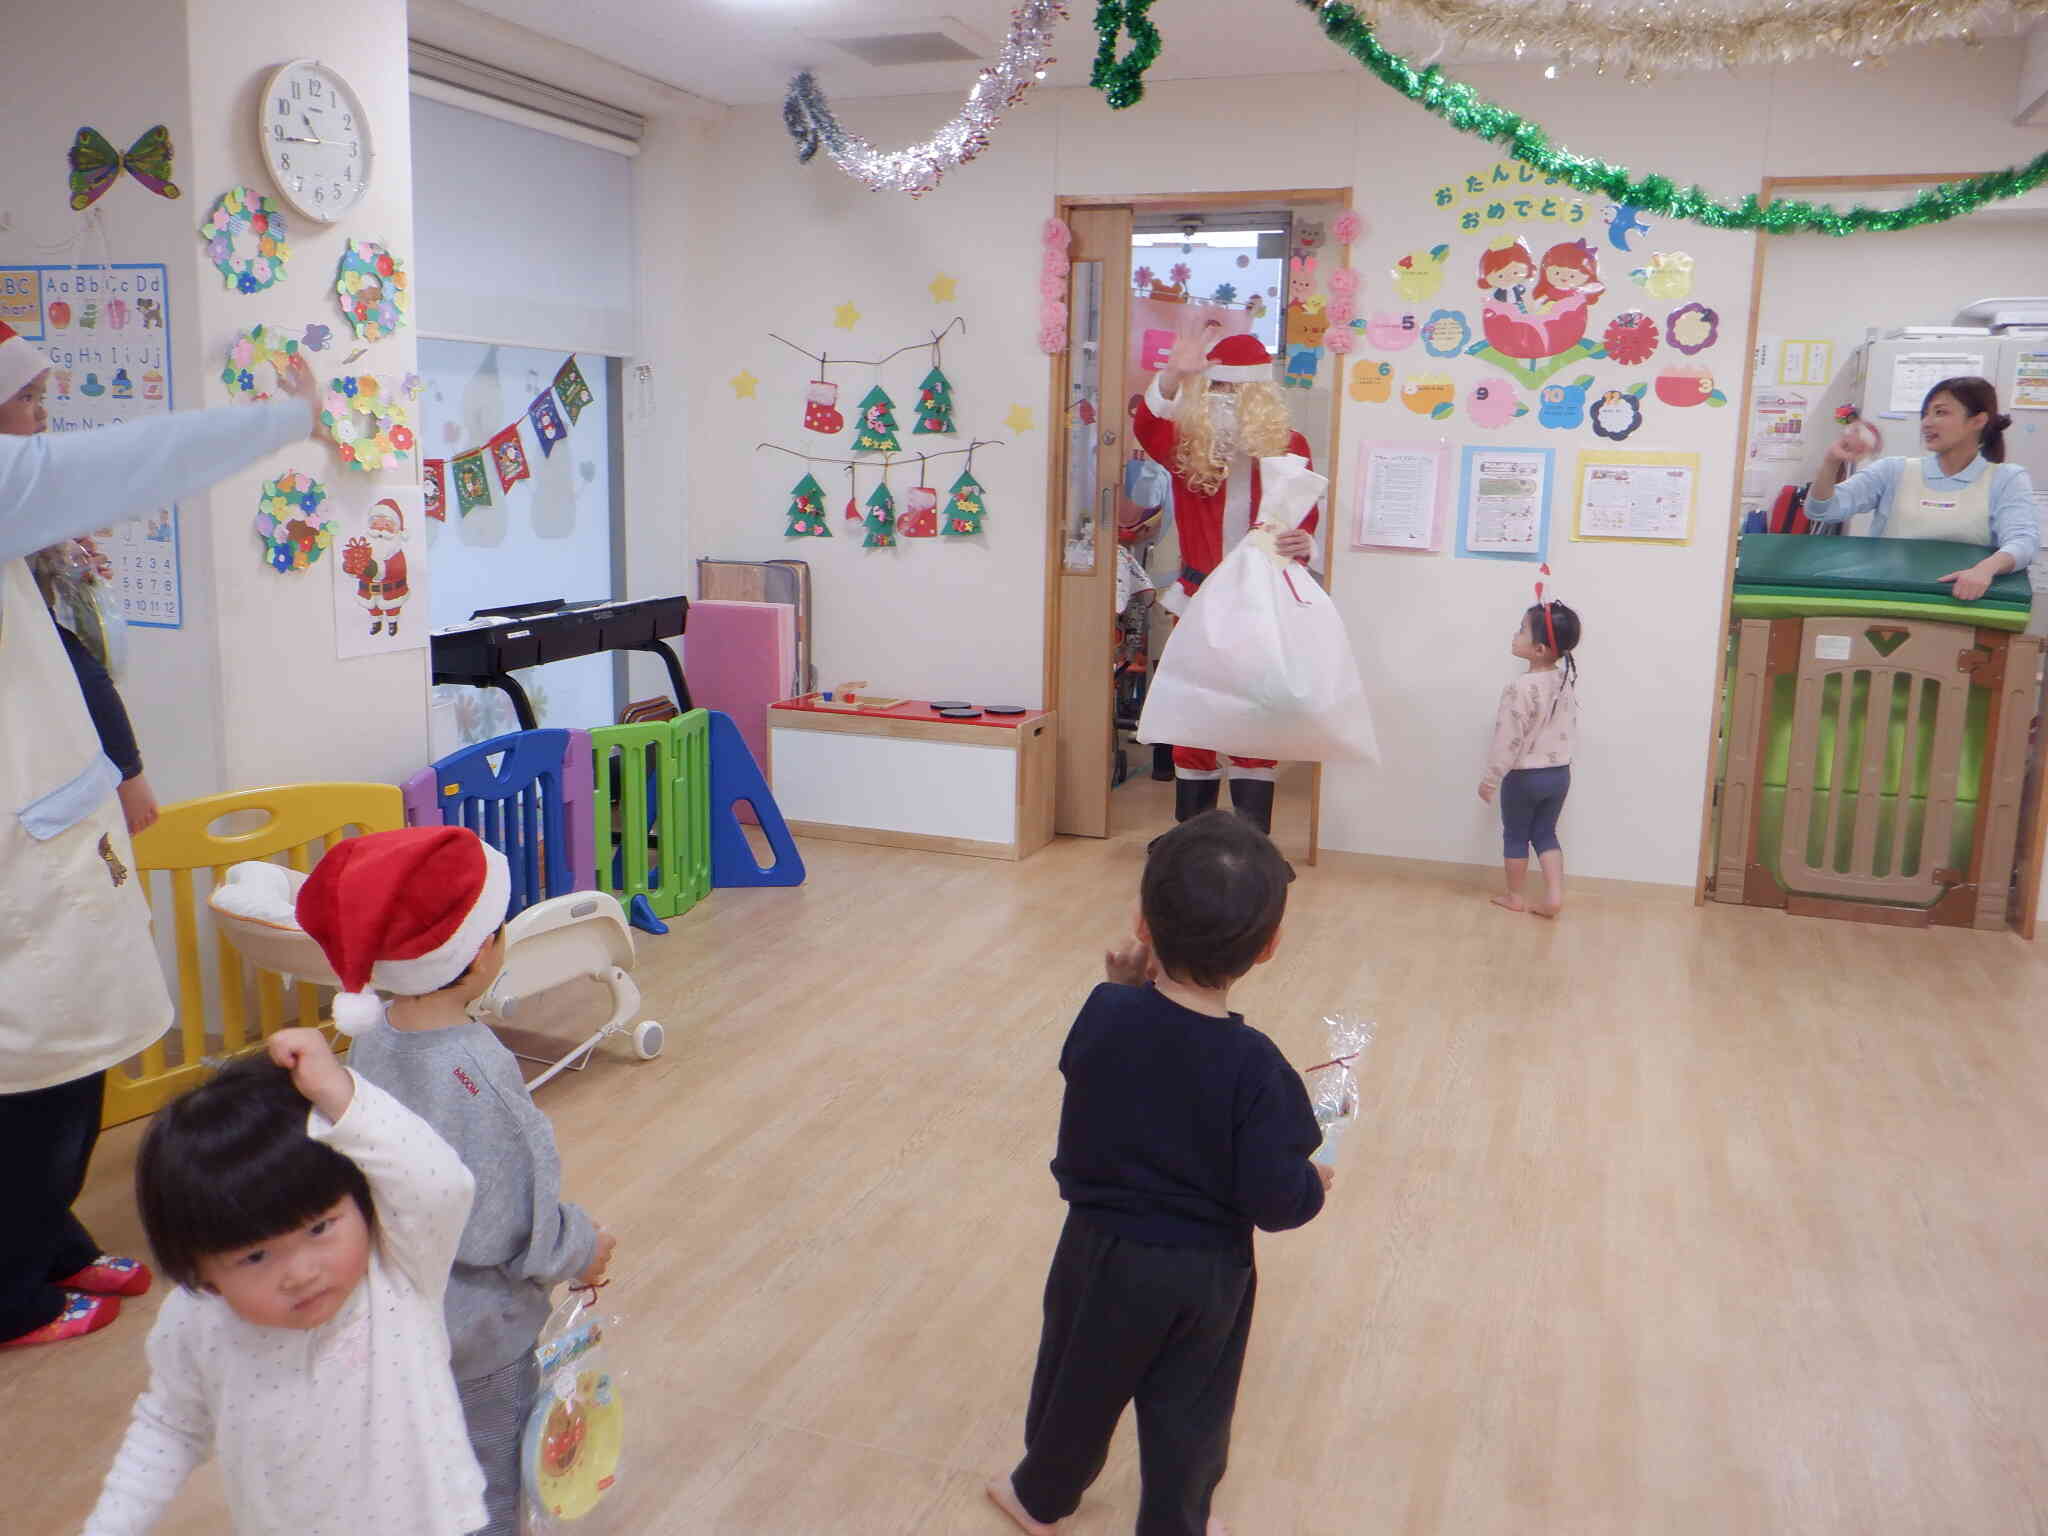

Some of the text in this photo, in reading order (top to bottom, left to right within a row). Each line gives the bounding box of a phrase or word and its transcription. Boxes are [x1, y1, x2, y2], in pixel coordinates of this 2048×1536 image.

[291, 81, 301, 100] 11
[308, 78, 321, 97] 12
[278, 98, 290, 116] 10
[330, 91, 337, 108] 1
[343, 114, 352, 131] 2
[274, 124, 285, 142] 9
[349, 142, 358, 158] 3
[281, 153, 291, 170] 8
[344, 165, 351, 182] 4
[315, 187, 325, 204] 6
[333, 184, 343, 200] 5
[1461, 198, 1584, 229] おめでとう
[1398, 255, 1413, 270] 4
[0, 276, 30, 297] BC
[1402, 315, 1415, 331] 5
[1378, 361, 1391, 377] 6
[1476, 387, 1489, 401] 9
[1698, 378, 1714, 394] 3
[1543, 388, 1565, 403] 10
[149, 557, 157, 569] 3
[164, 580, 173, 592] 8
[136, 600, 147, 612] 10
[150, 600, 159, 612] 11
[164, 601, 176, 614] 12
